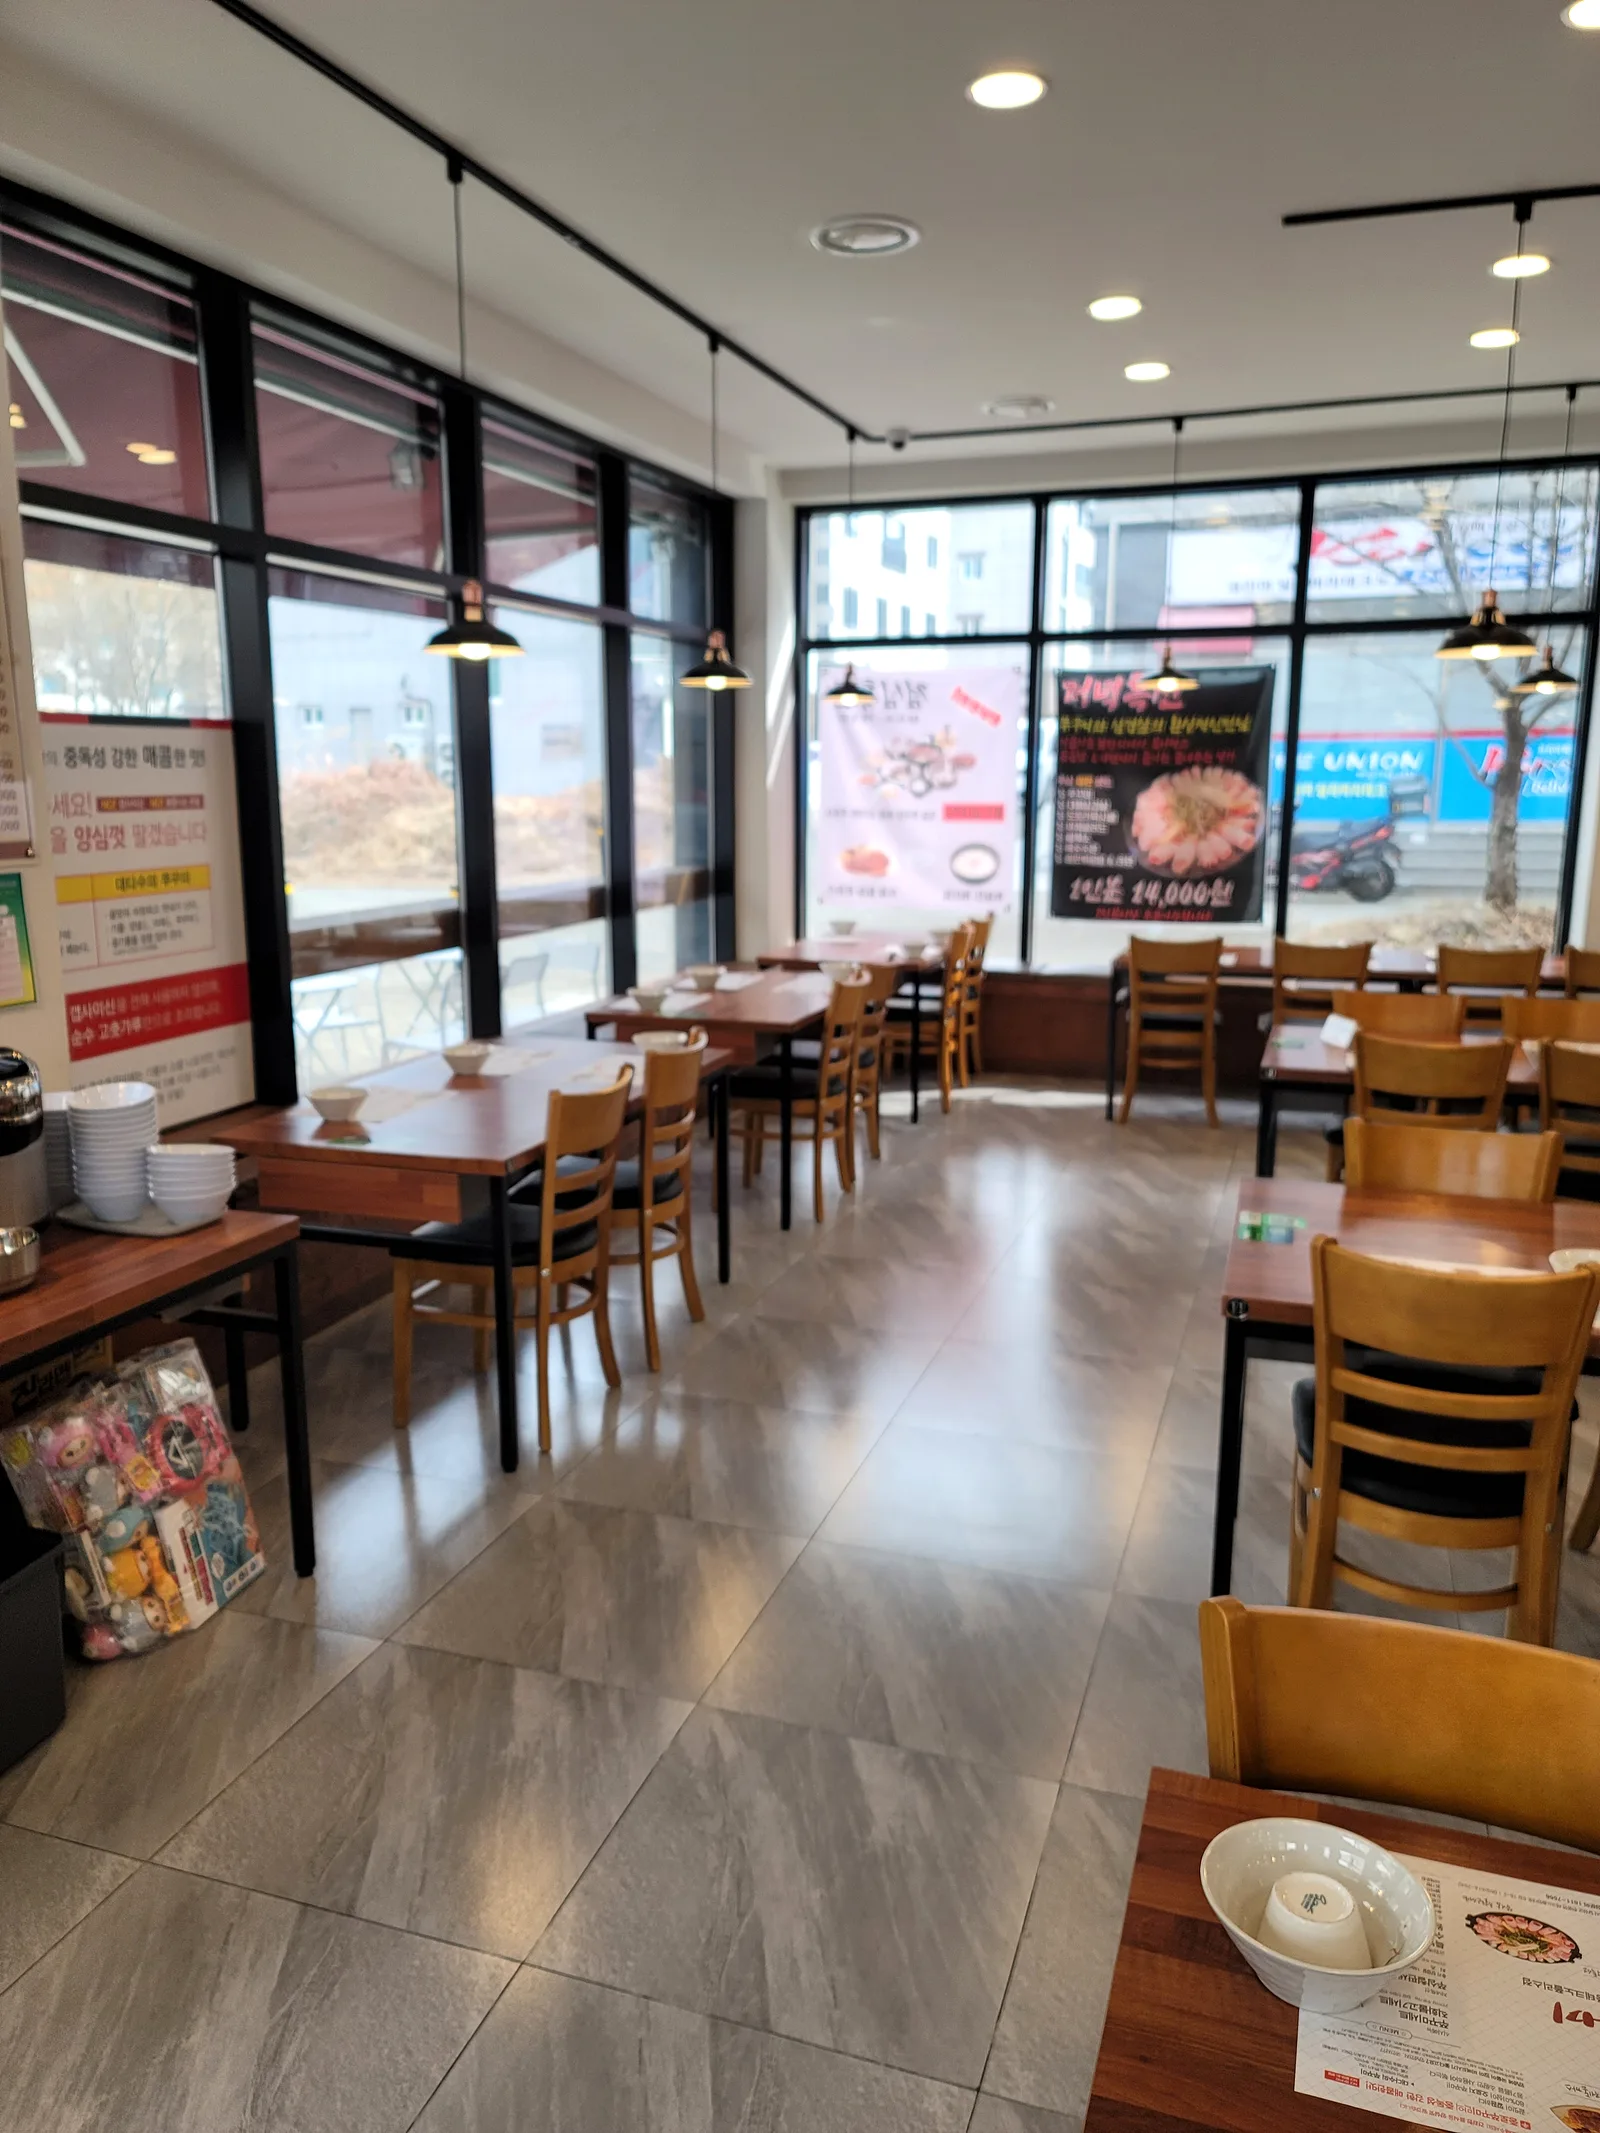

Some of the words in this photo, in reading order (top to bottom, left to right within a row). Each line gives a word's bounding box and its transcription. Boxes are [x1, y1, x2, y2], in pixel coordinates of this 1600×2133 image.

[63, 746, 105, 768] 중독성
[110, 746, 137, 768] 강한
[1323, 751, 1423, 771] UNION
[73, 824, 125, 852] 양심껏
[131, 820, 206, 848] 팔겠습니다
[1376, 1994, 1448, 2018] 직화불고기세트
[1397, 2009, 1449, 2029] 쭈꾸미세트
[1378, 2025, 1400, 2034] MENU
[1359, 2068, 1380, 2079] 쭈꾸미
[1381, 2074, 1408, 2086] 대다수의
[1405, 2090, 1424, 2102] 강한
[1426, 2095, 1454, 2109] 중독성
